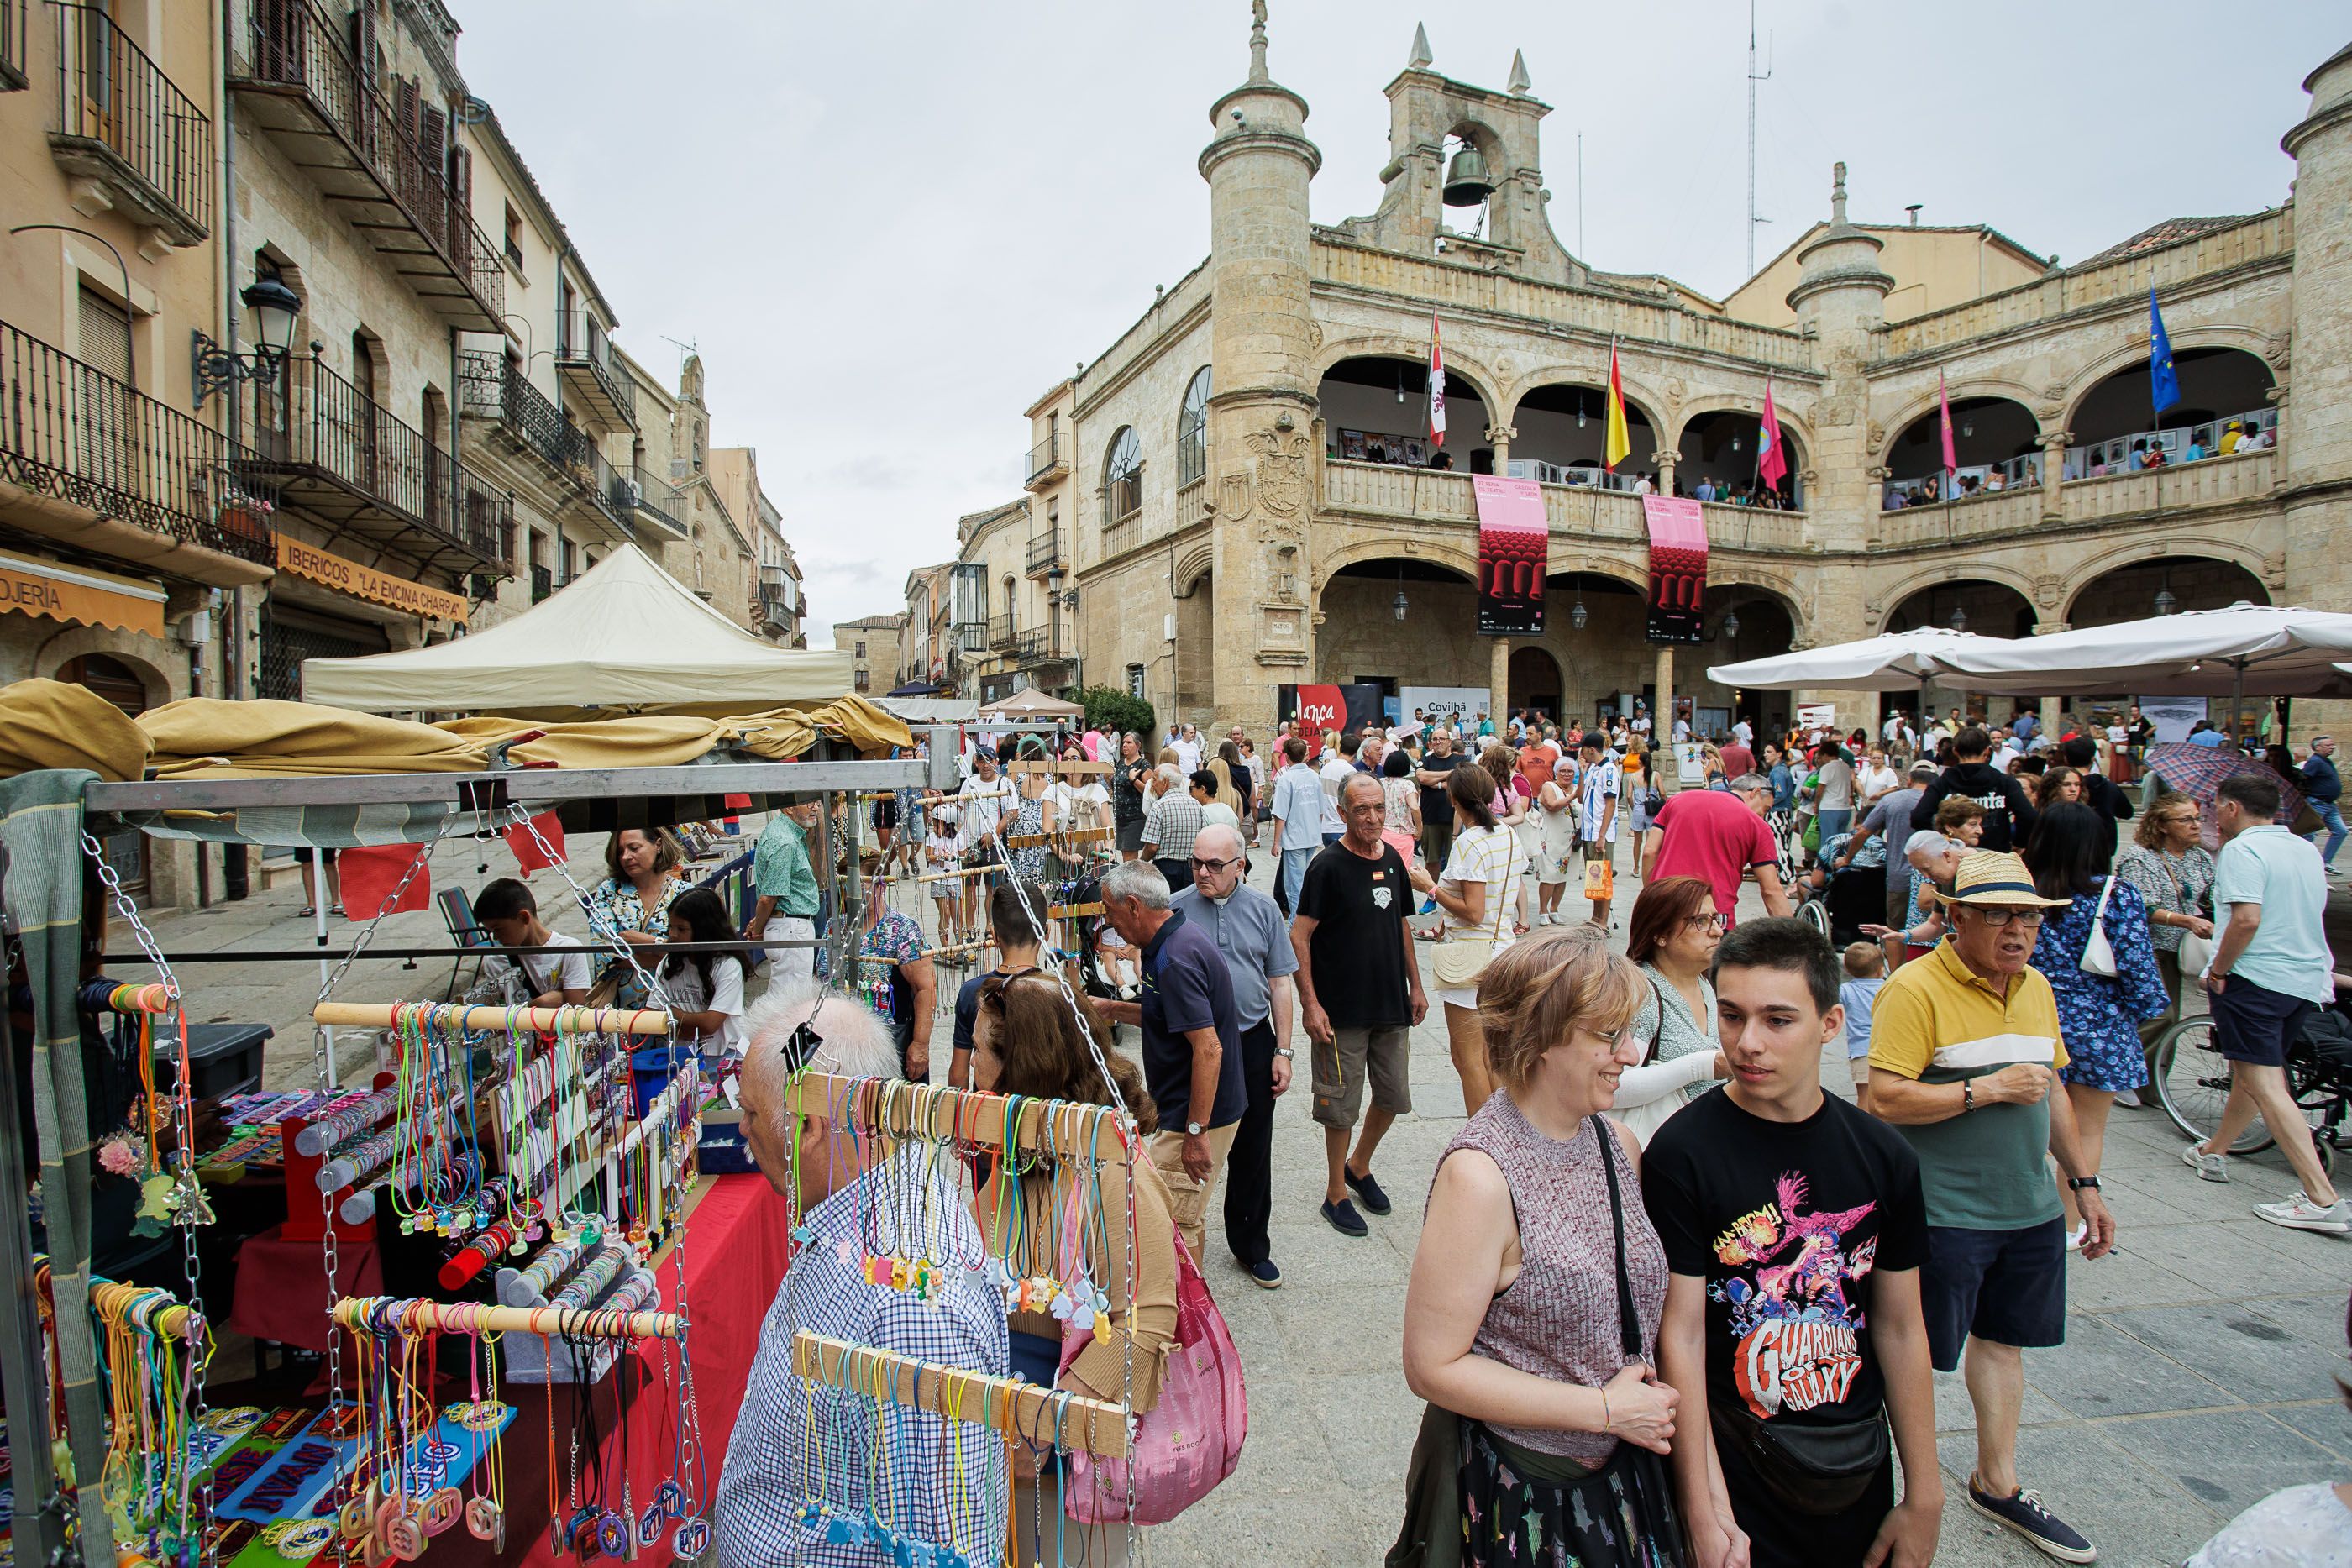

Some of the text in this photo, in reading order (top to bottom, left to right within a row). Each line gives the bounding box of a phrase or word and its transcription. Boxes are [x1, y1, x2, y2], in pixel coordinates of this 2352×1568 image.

[288, 546, 350, 585] IBERICOS
[381, 581, 419, 606] ENCINA
[1428, 701, 1466, 712] Covilhã
[1747, 1318, 1857, 1415] GUARDIANS
[1780, 1351, 1861, 1382] OF THE
[1780, 1360, 1862, 1412] GALAXY
[1172, 1443, 1185, 1453] YVES
